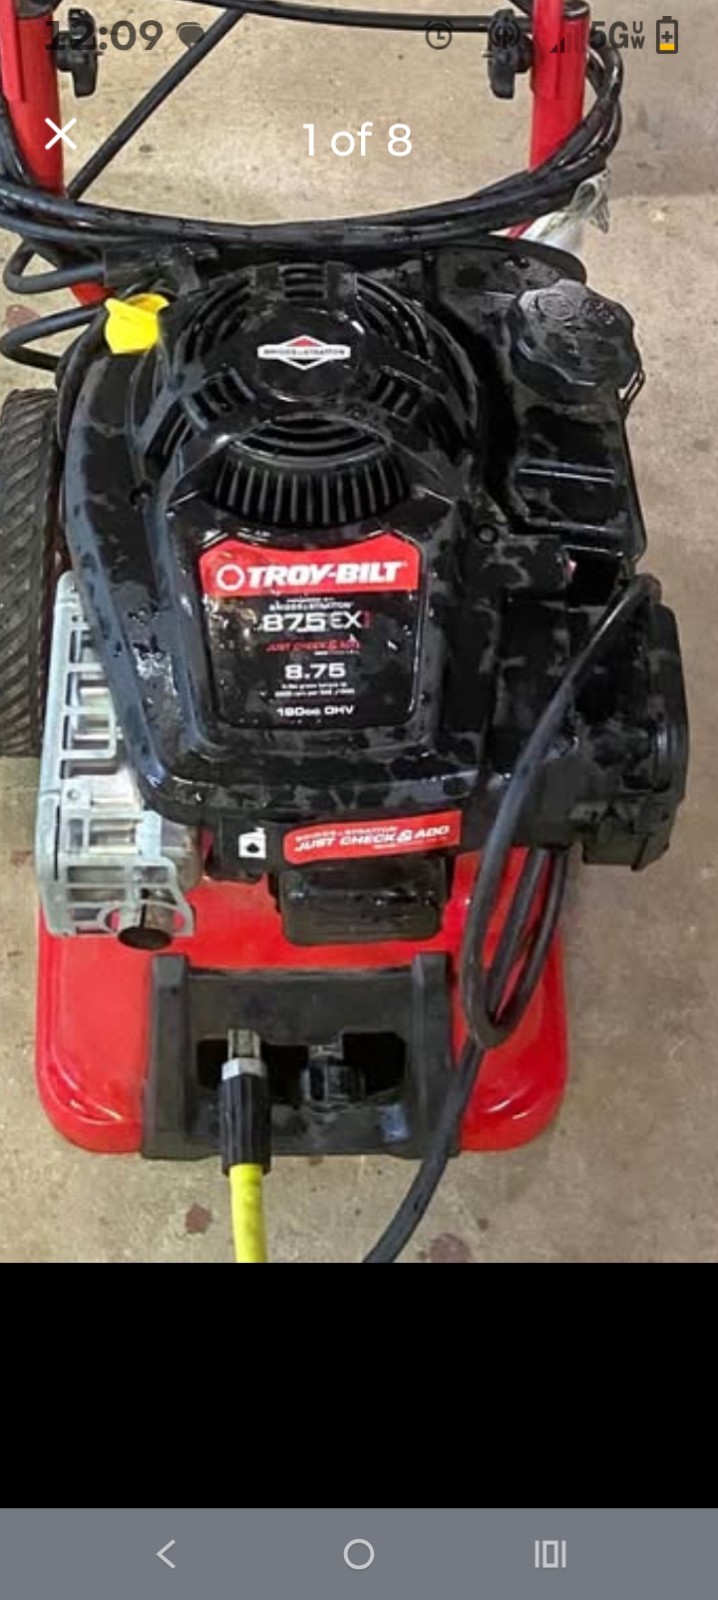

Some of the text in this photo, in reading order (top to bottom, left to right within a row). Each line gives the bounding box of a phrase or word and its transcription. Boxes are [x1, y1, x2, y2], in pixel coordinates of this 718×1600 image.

[247, 561, 403, 588] TROY-BILT
[284, 663, 346, 680] 8.75
[324, 705, 355, 715] OHV
[294, 837, 336, 852] JUST
[339, 832, 397, 846] CHECK
[397, 829, 414, 843] &
[414, 825, 450, 840] ADD
